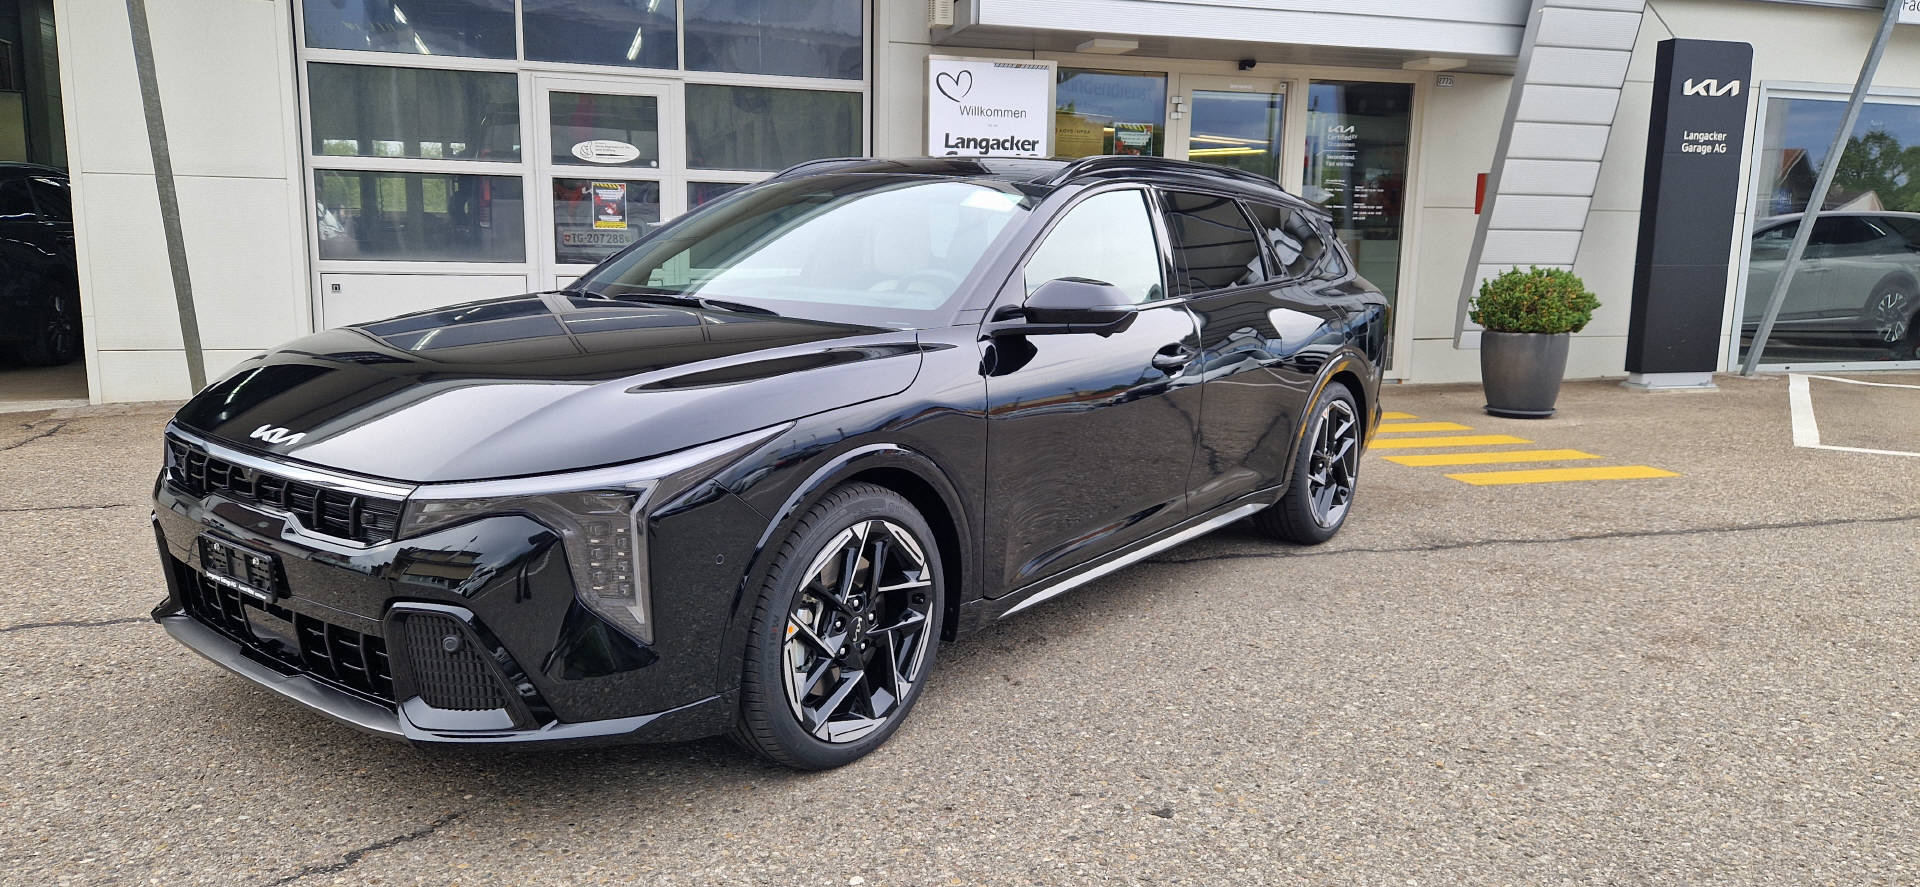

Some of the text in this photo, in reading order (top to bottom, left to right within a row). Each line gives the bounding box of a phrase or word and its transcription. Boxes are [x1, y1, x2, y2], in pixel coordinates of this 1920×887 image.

[1683, 78, 1740, 97] KIA
[959, 105, 1027, 118] Willkommen
[944, 132, 1040, 155] Langacker
[1683, 130, 1727, 142] Langacker
[1681, 142, 1727, 155] Garage AG
[249, 423, 308, 447] KIA
